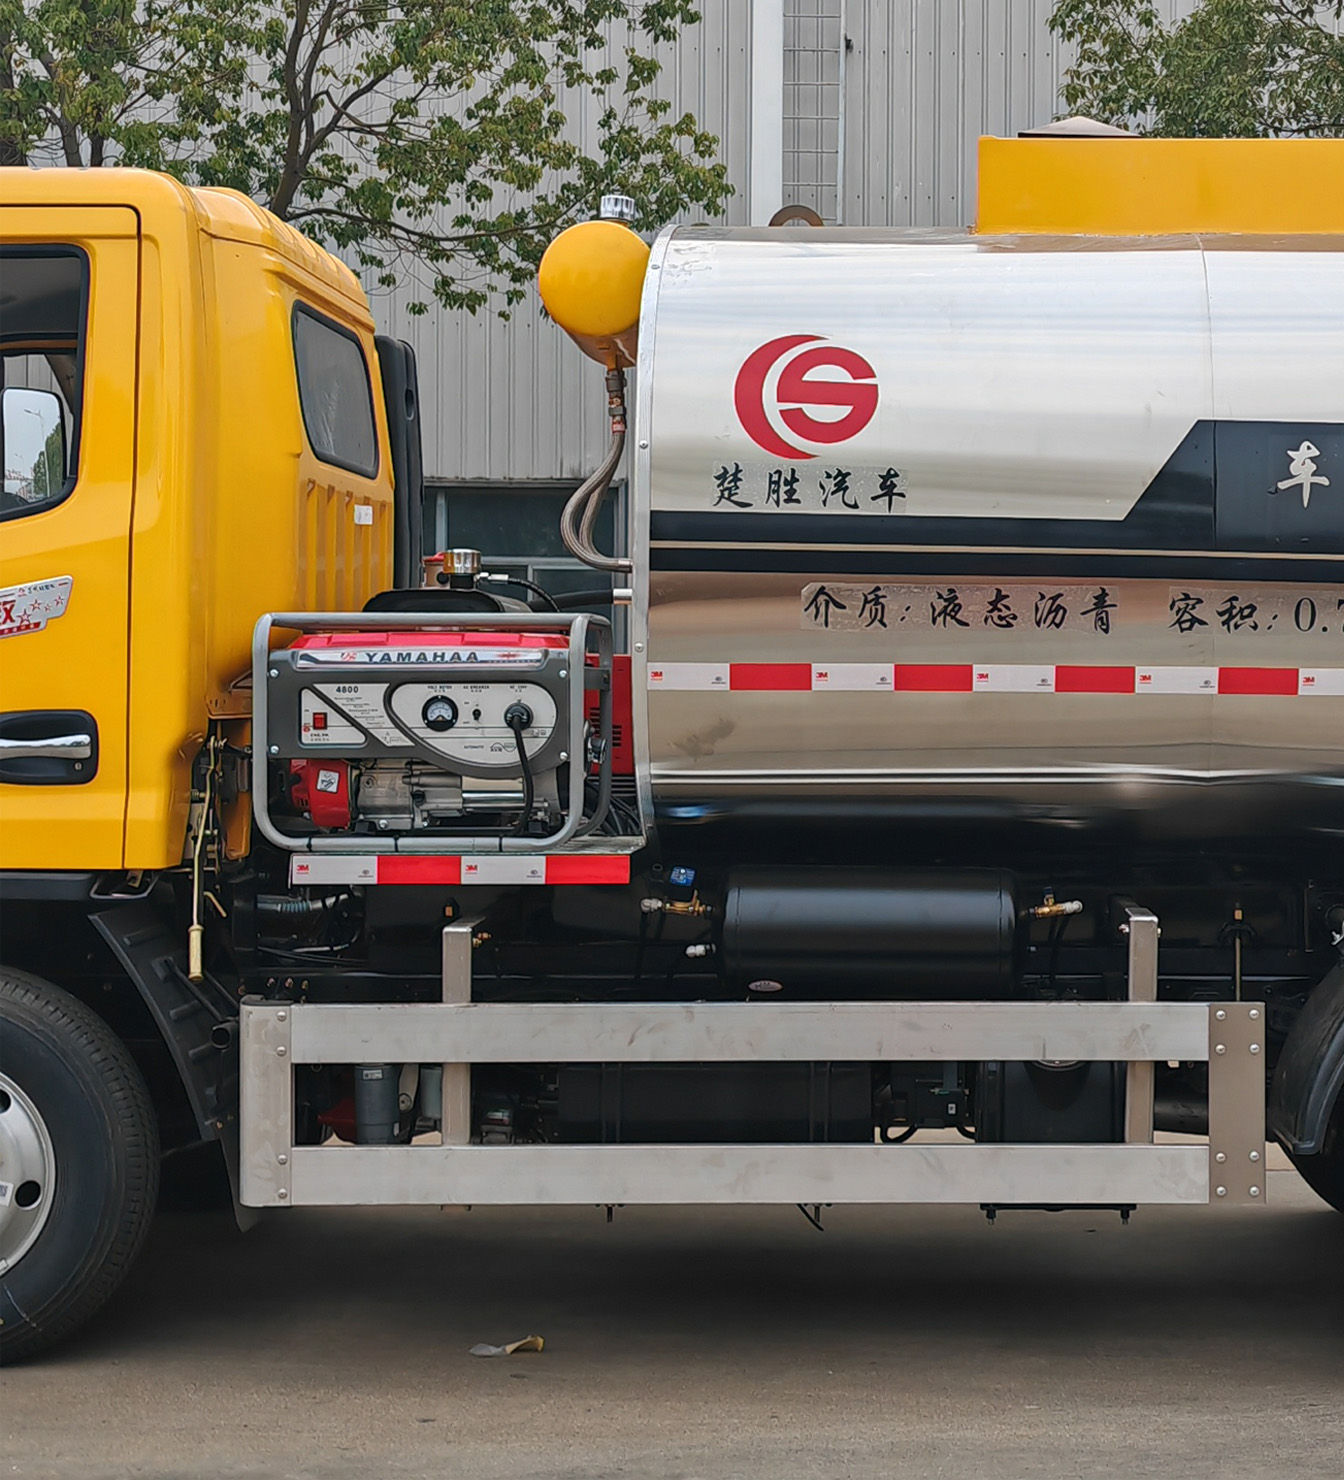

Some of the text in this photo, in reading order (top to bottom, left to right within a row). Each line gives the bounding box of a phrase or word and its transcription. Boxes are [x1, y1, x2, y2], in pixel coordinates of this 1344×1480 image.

[713, 462, 906, 513] 楚胜汽车
[365, 652, 479, 663] YAMAHAA
